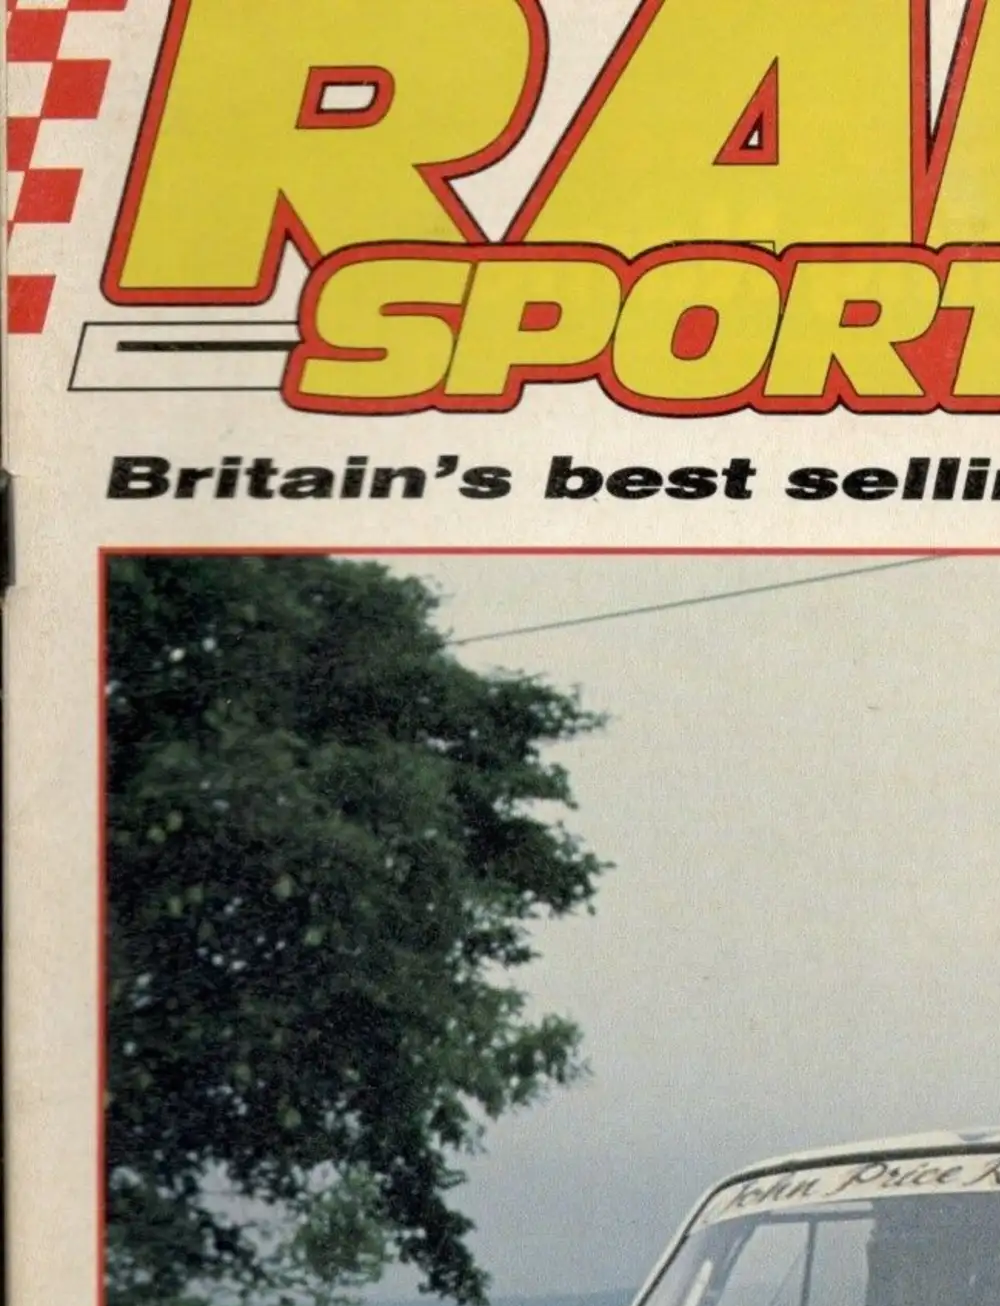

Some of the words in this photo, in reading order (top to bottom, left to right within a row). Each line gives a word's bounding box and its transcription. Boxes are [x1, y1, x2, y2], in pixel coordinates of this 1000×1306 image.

[107, 455, 512, 500] Britain's
[544, 455, 757, 500] best
[832, 1158, 964, 1197] Price
